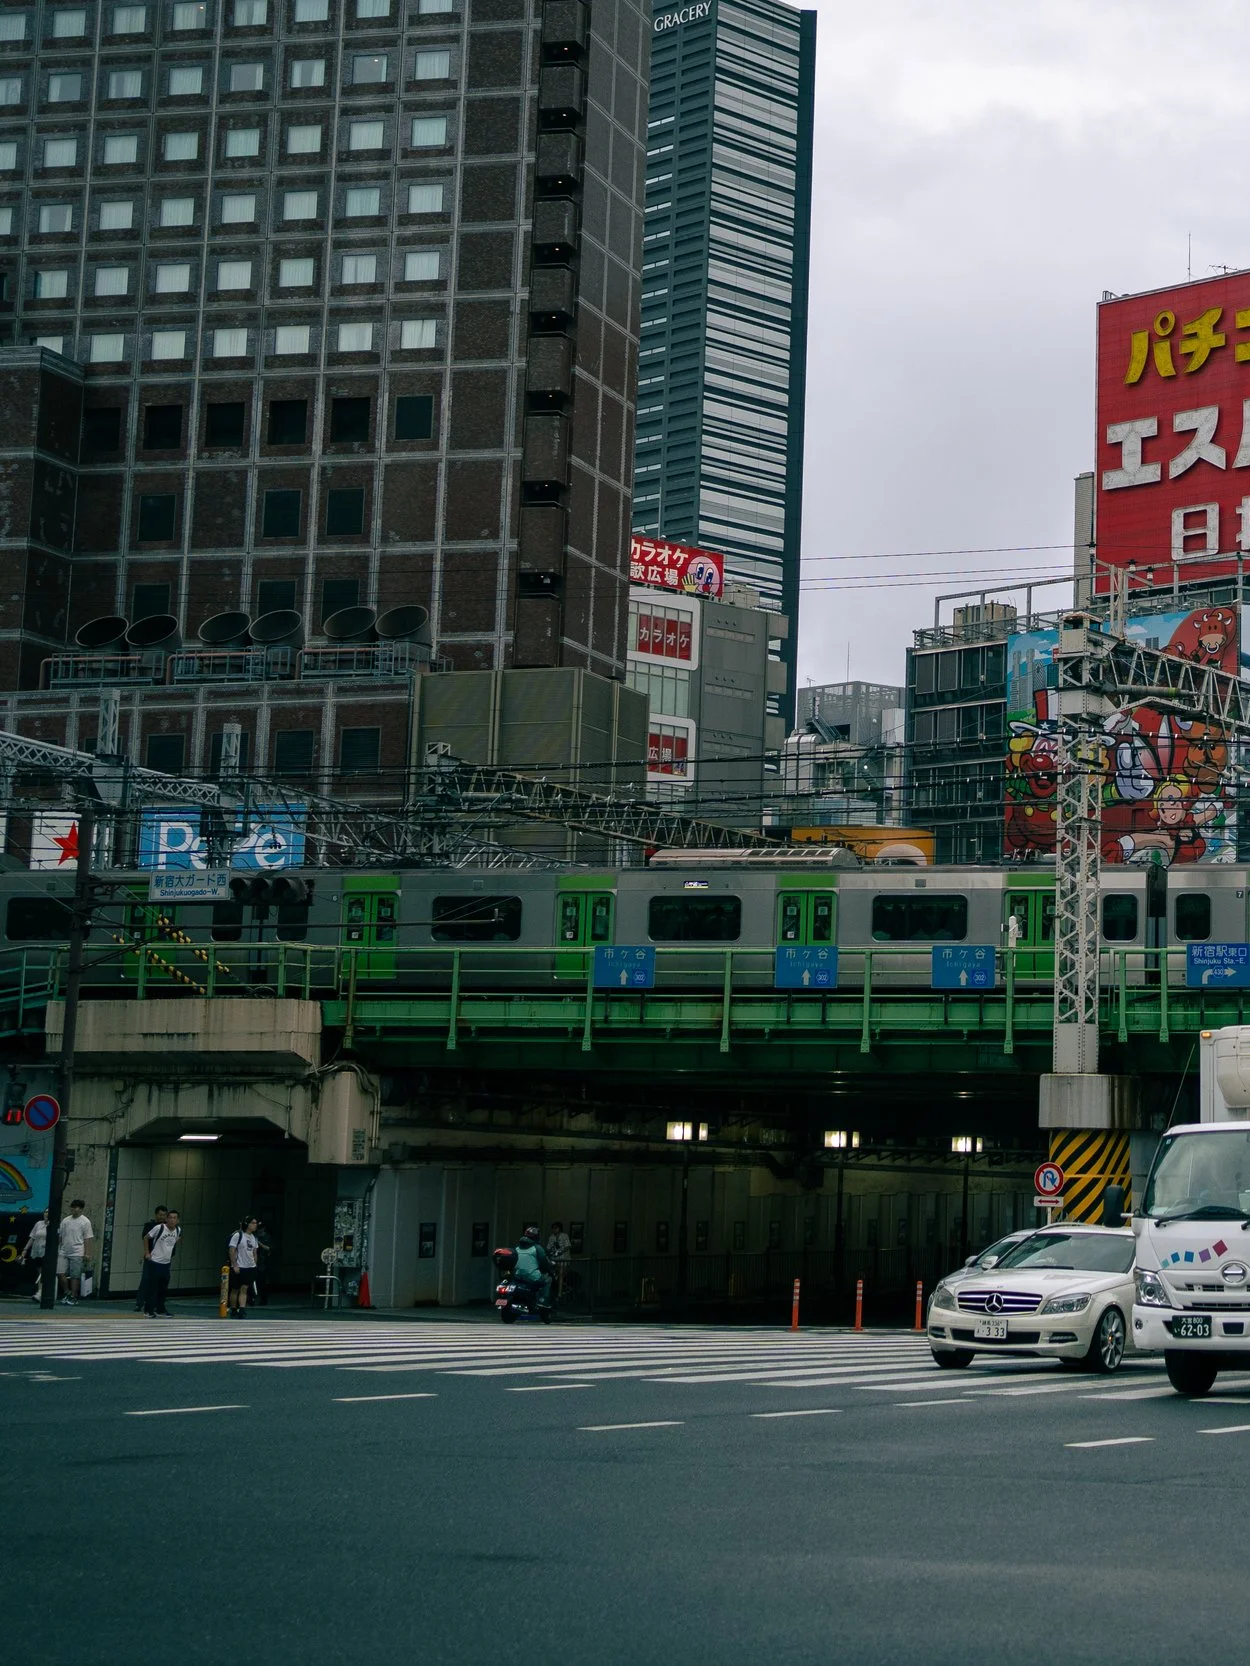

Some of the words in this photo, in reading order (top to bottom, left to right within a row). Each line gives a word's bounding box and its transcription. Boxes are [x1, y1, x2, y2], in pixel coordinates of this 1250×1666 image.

[654, 1, 711, 31] GRACERY
[639, 627, 690, 650] カラオケ
[154, 873, 227, 888] 新宿大ガード西
[1191, 944, 1248, 958] 新宿駅東口
[1193, 957, 1222, 965] Shinjuku
